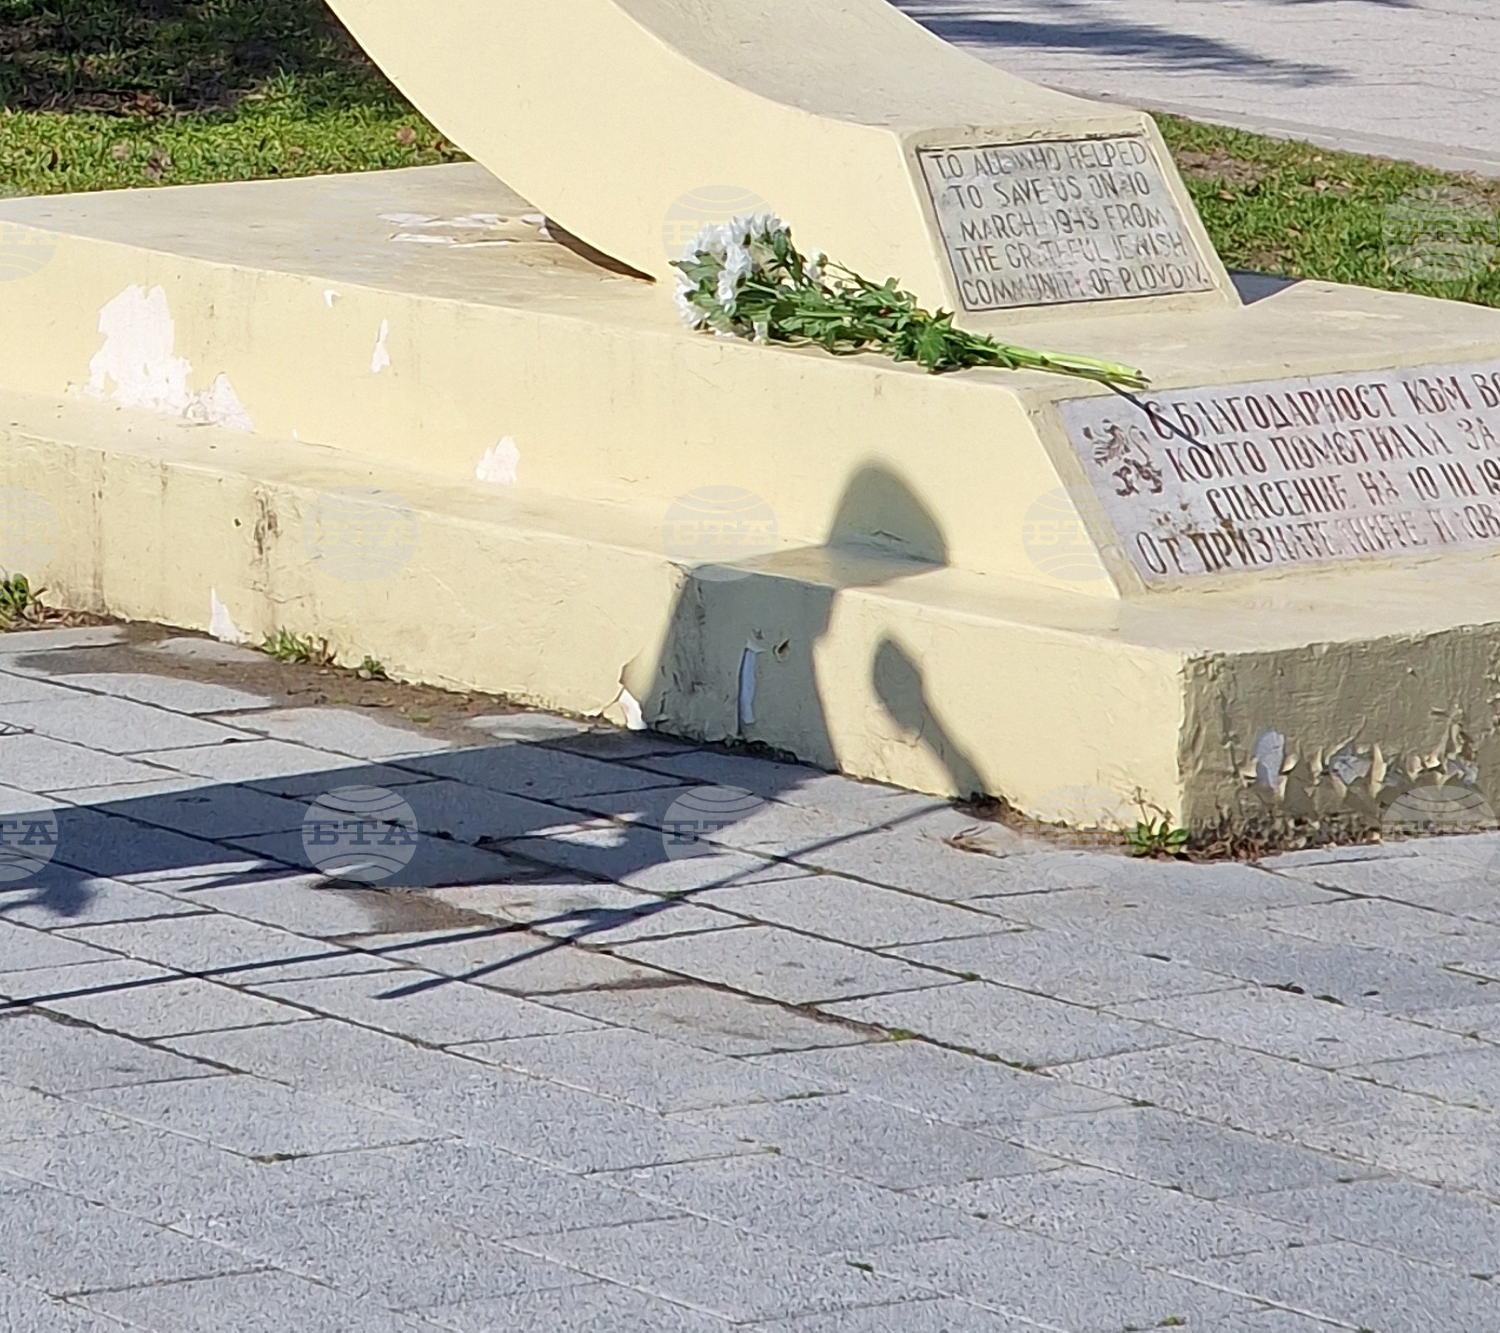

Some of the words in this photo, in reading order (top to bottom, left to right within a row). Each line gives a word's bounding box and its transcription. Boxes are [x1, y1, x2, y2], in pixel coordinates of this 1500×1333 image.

[928, 154, 964, 179] TO
[974, 151, 1012, 177] ALL
[1065, 140, 1148, 170] HELPED
[948, 184, 983, 210] TO
[993, 178, 1049, 208] SAVE
[1052, 175, 1082, 202] US
[1087, 171, 1119, 200] ON
[1127, 171, 1150, 196] 10
[960, 211, 1039, 242] MARCH
[1048, 207, 1100, 235] 1943
[1103, 202, 1169, 232] FROM
[955, 244, 1002, 275] THE
[1111, 230, 1188, 261] JEWISH
[1088, 267, 1117, 296] OF
[1171, 383, 1397, 438] БЛАГОДАРНОСТ
[1402, 375, 1472, 416] КЪМ
[1206, 475, 1356, 522] СПАСЕНИЕ
[1357, 470, 1403, 507] НА
[1408, 466, 1440, 501] 10
[1476, 458, 1500, 496] 19
[1136, 531, 1189, 575] ОТ
